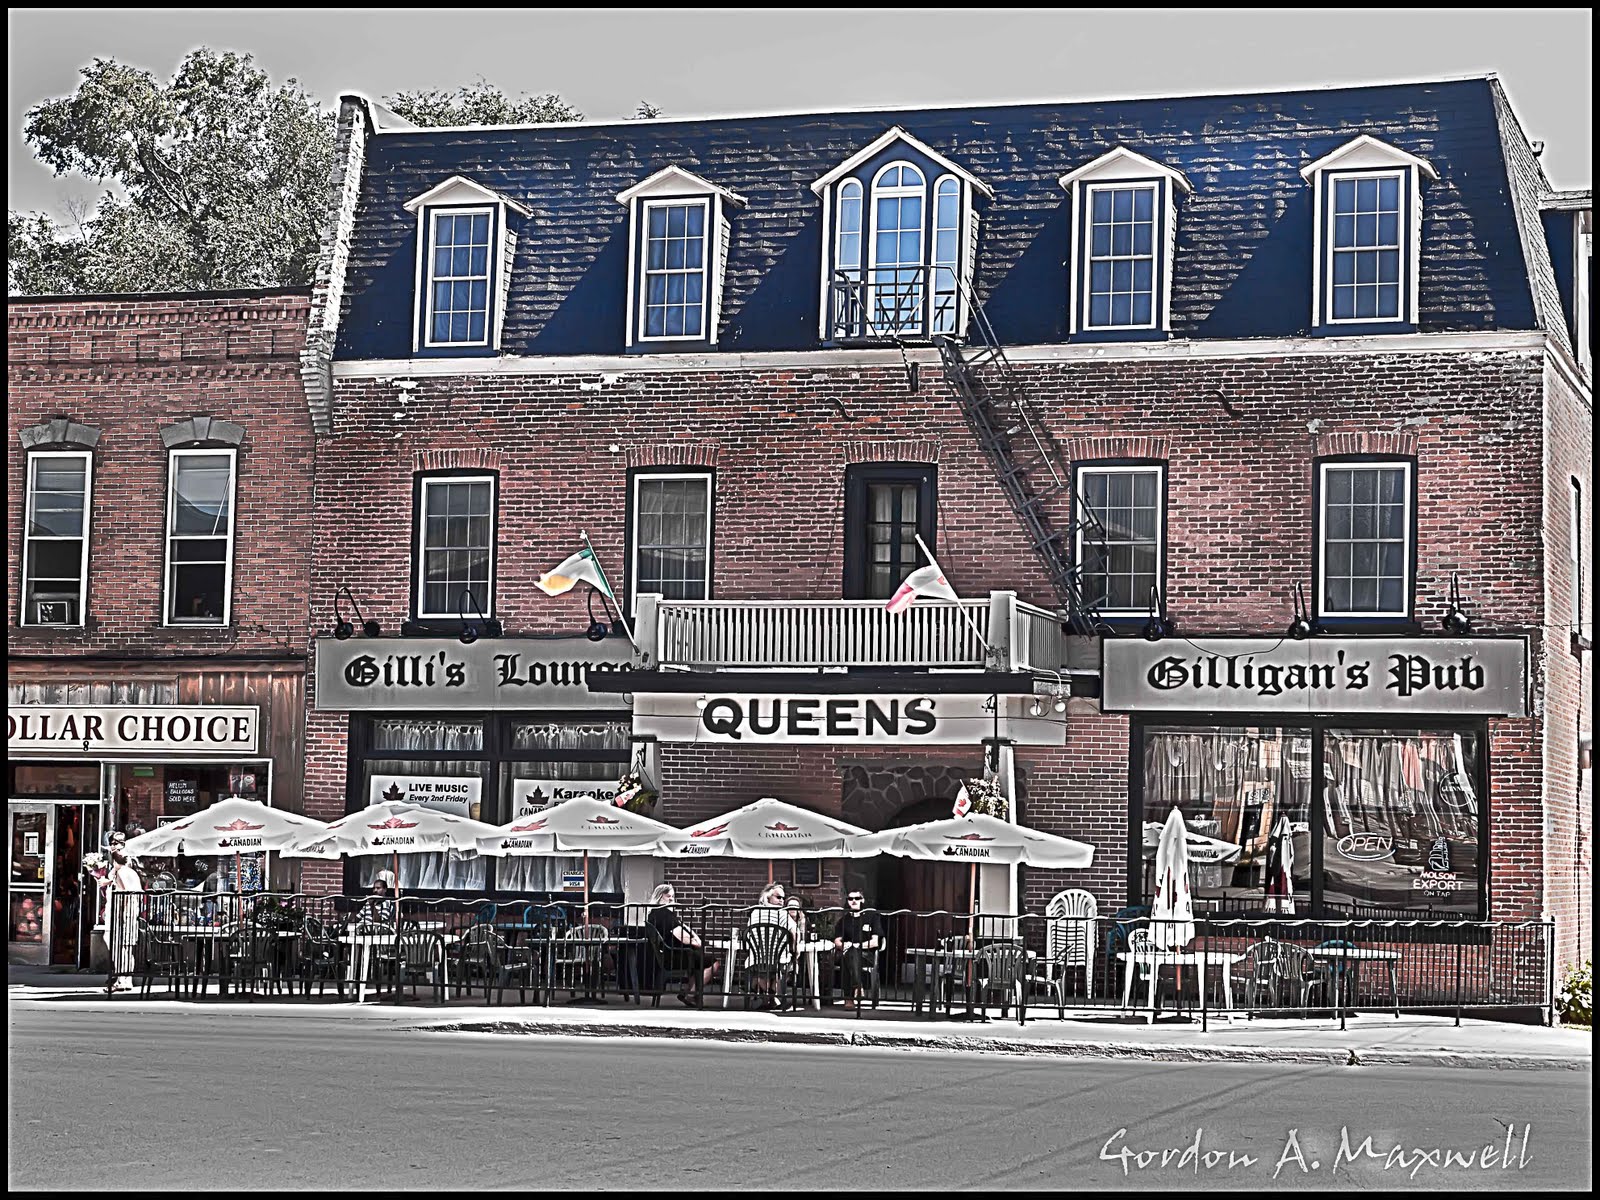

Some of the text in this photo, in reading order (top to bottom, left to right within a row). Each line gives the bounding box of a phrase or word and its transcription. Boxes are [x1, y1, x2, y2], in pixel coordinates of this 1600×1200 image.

[344, 650, 466, 687] Gilli's
[1147, 650, 1485, 696] Gilligan's Pub
[702, 697, 937, 740] QUEENS
[117, 715, 250, 743] CHOICE
[82, 740, 90, 751] 8
[408, 783, 469, 793] LIVE MUSIC
[409, 794, 430, 803] Every
[445, 795, 469, 804] Friday
[552, 788, 614, 800] Karaoke
[229, 837, 262, 847] CANADIAN
[382, 836, 415, 846] CANADIAN
[508, 839, 533, 849] CANADIAN
[1338, 836, 1393, 852] OPEN
[688, 846, 711, 855] CANADIAN
[955, 847, 990, 857] CANADIAN
[1419, 871, 1457, 881] MOLSON
[1413, 879, 1464, 891] EXPORT
[1436, 890, 1451, 898] TAP
